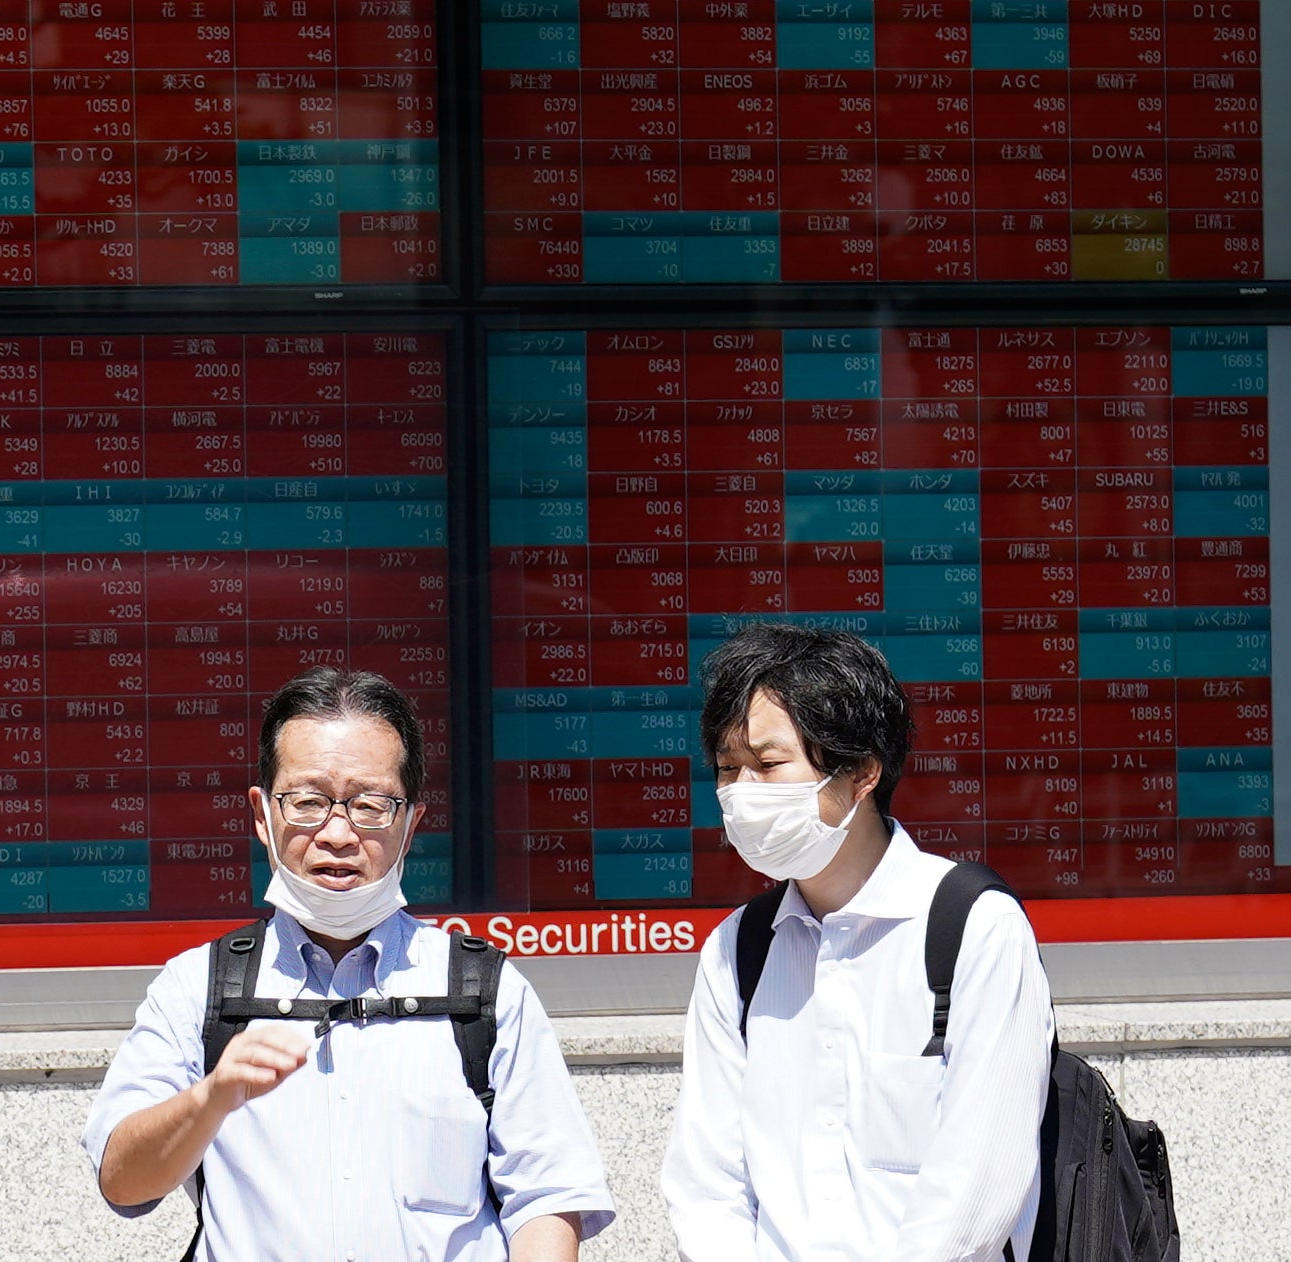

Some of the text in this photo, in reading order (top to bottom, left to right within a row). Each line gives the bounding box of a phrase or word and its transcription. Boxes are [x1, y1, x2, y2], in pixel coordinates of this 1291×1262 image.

[196, 25, 231, 41] 5399
[297, 24, 332, 40] 4454
[386, 23, 432, 40] 2059.0
[641, 26, 675, 41] 5820
[740, 26, 773, 41] 3882
[837, 26, 871, 41] 9192
[934, 26, 969, 42] 4363
[1128, 26, 1162, 42] 5250
[1213, 26, 1257, 42] 2649.0
[205, 48, 231, 64] +28
[306, 48, 333, 63] +46
[650, 49, 675, 65] +32
[704, 73, 753, 89] ENEOS
[85, 98, 131, 113] 1055.0
[194, 96, 234, 113] 541.8
[543, 97, 577, 113] 6379
[630, 97, 677, 112] 2904.5
[736, 97, 774, 112] 496.2
[839, 97, 872, 112] 3056
[936, 97, 970, 112] 5746
[1032, 96, 1067, 112] 4936
[1137, 97, 1163, 112] 639
[1214, 96, 1258, 112] 2520.0
[3, 122, 30, 138] +76
[745, 120, 775, 136] +1.2
[98, 170, 133, 185] 4233
[188, 169, 234, 184] 1700.5
[533, 168, 578, 184] 2001.5
[645, 168, 678, 184] 1562
[730, 168, 775, 183] 2984.0
[1034, 167, 1067, 182] 4664
[1215, 167, 1259, 182] 2579.0
[538, 240, 579, 255] 76440
[1223, 237, 1260, 252] 898.8
[307, 361, 342, 377] 5967
[407, 360, 442, 376] 6223
[647, 357, 681, 373] 8643
[734, 356, 780, 373] 2840.0
[1027, 354, 1072, 370] 2677.0
[1124, 353, 1168, 370] 2211.0
[104, 363, 140, 379] 8884
[194, 362, 241, 378] 2000.0
[400, 431, 443, 447] 66090
[637, 428, 682, 444] 1178.5
[845, 426, 879, 442] 7567
[1039, 425, 1071, 441] 8001
[1129, 424, 1169, 440] 10125
[195, 434, 242, 450] 2667.5
[1095, 471, 1154, 487] SUBARU
[645, 500, 683, 516] 600.6
[1041, 496, 1073, 511] 5407
[1126, 495, 1170, 510] 2573.0
[107, 507, 141, 523] 3827
[651, 572, 684, 587] 3068
[944, 568, 978, 583] 6266
[209, 578, 243, 594] 3789
[639, 644, 685, 658] 2715.0
[1042, 638, 1076, 652] 6130
[515, 693, 568, 708] MS&AD
[1033, 710, 1077, 723] 1722.5
[642, 788, 688, 801] 2626.0
[110, 796, 146, 812] 4329
[209, 865, 248, 882] 516.7
[488, 913, 695, 955] Securities
